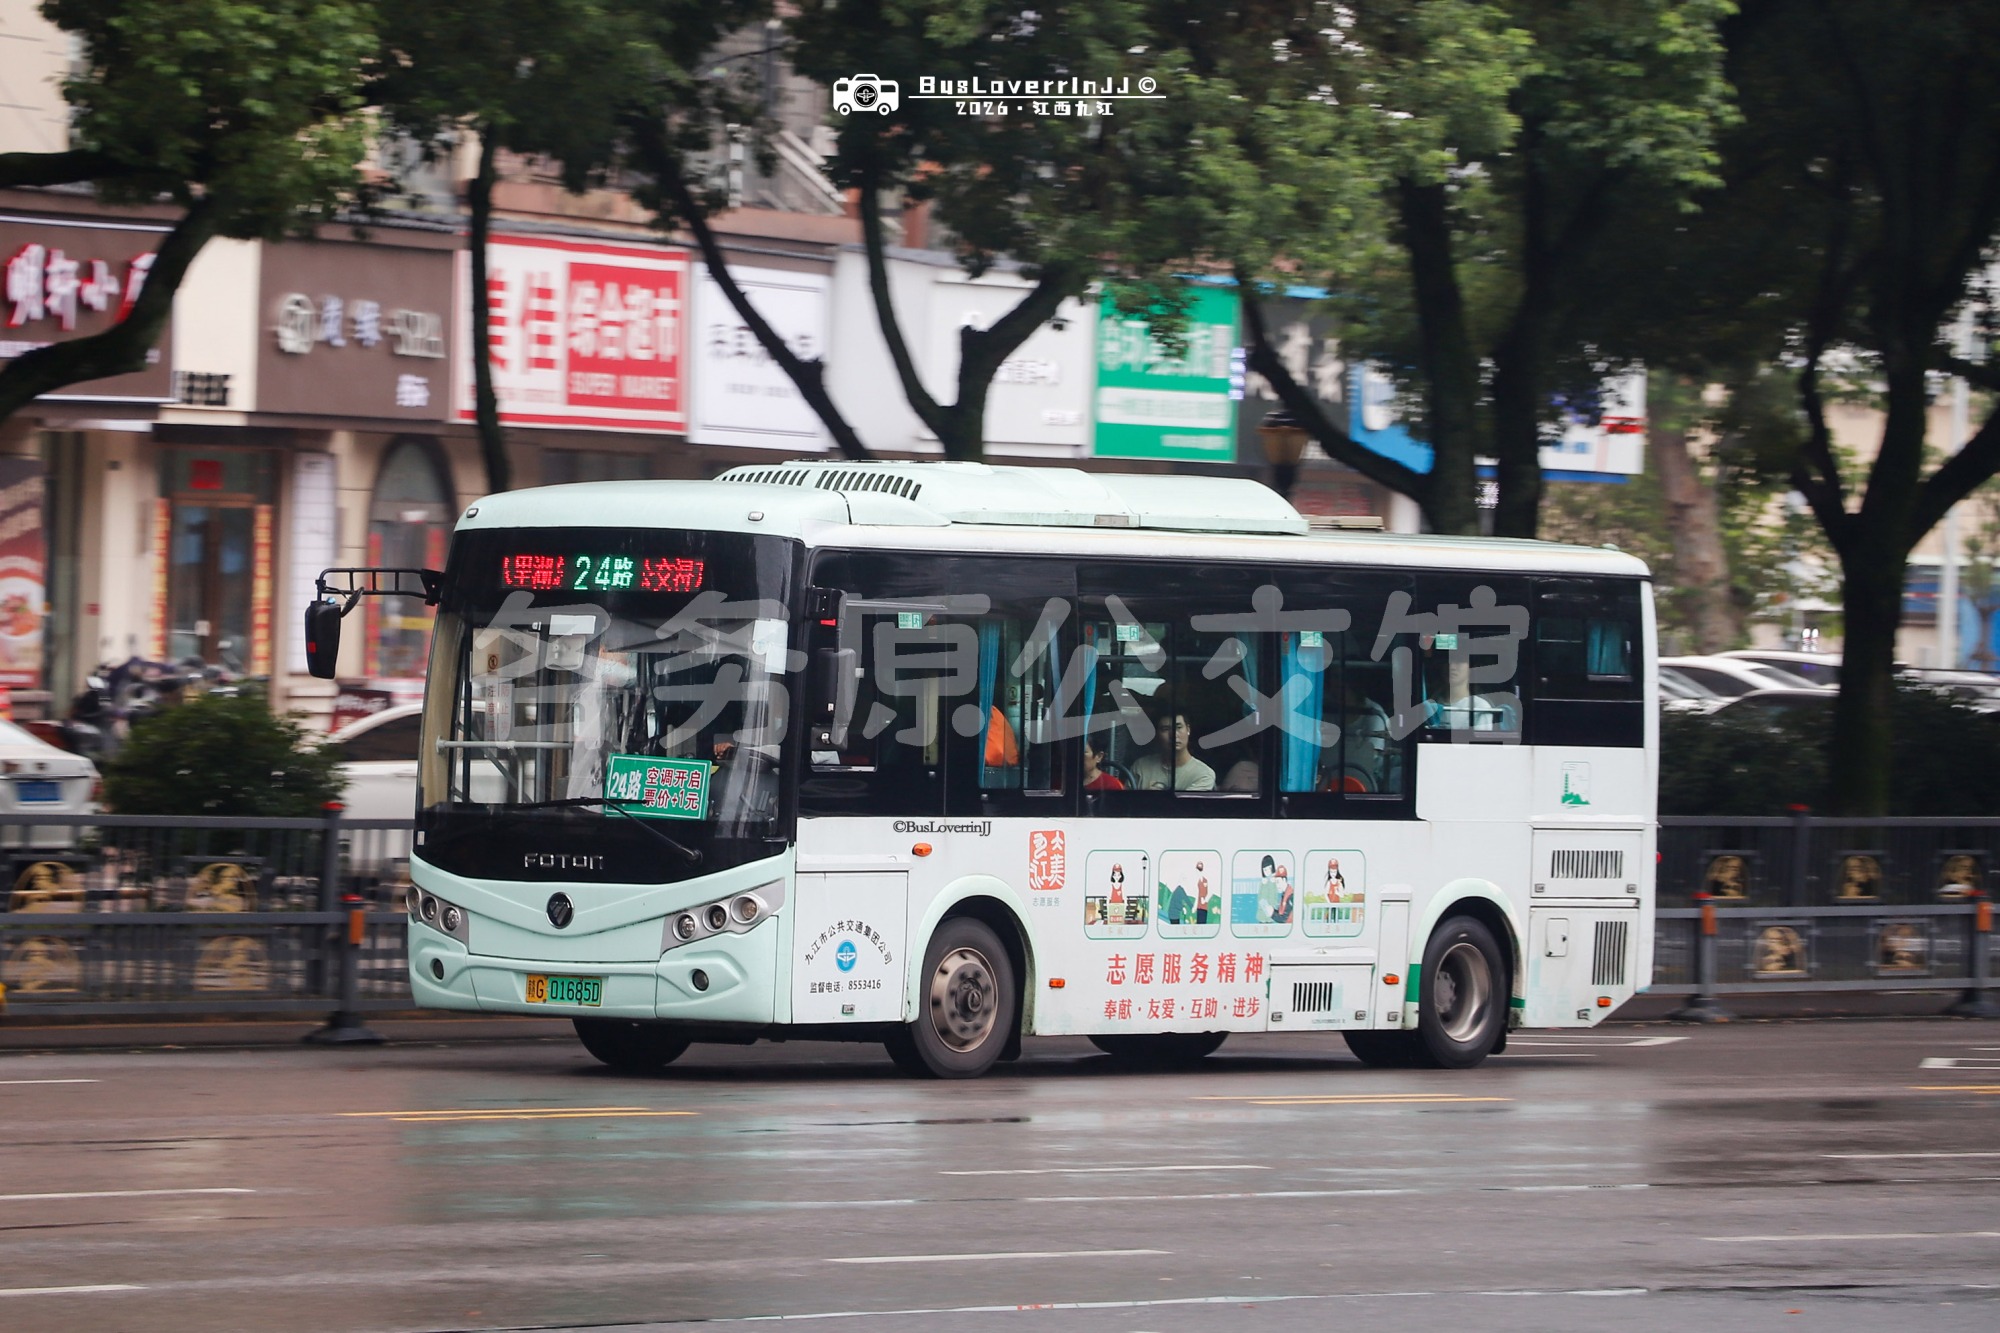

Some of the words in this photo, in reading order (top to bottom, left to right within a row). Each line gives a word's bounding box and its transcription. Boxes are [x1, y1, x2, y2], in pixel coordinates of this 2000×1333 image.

[573, 556, 634, 590] 24路
[609, 769, 642, 802] 24路
[645, 766, 702, 789] 空调开启
[642, 788, 701, 811] 票价+1元
[524, 852, 604, 870] FOTON
[804, 919, 893, 966] 九江市公共交通集团公司
[1106, 951, 1265, 986] 志愿服务精神
